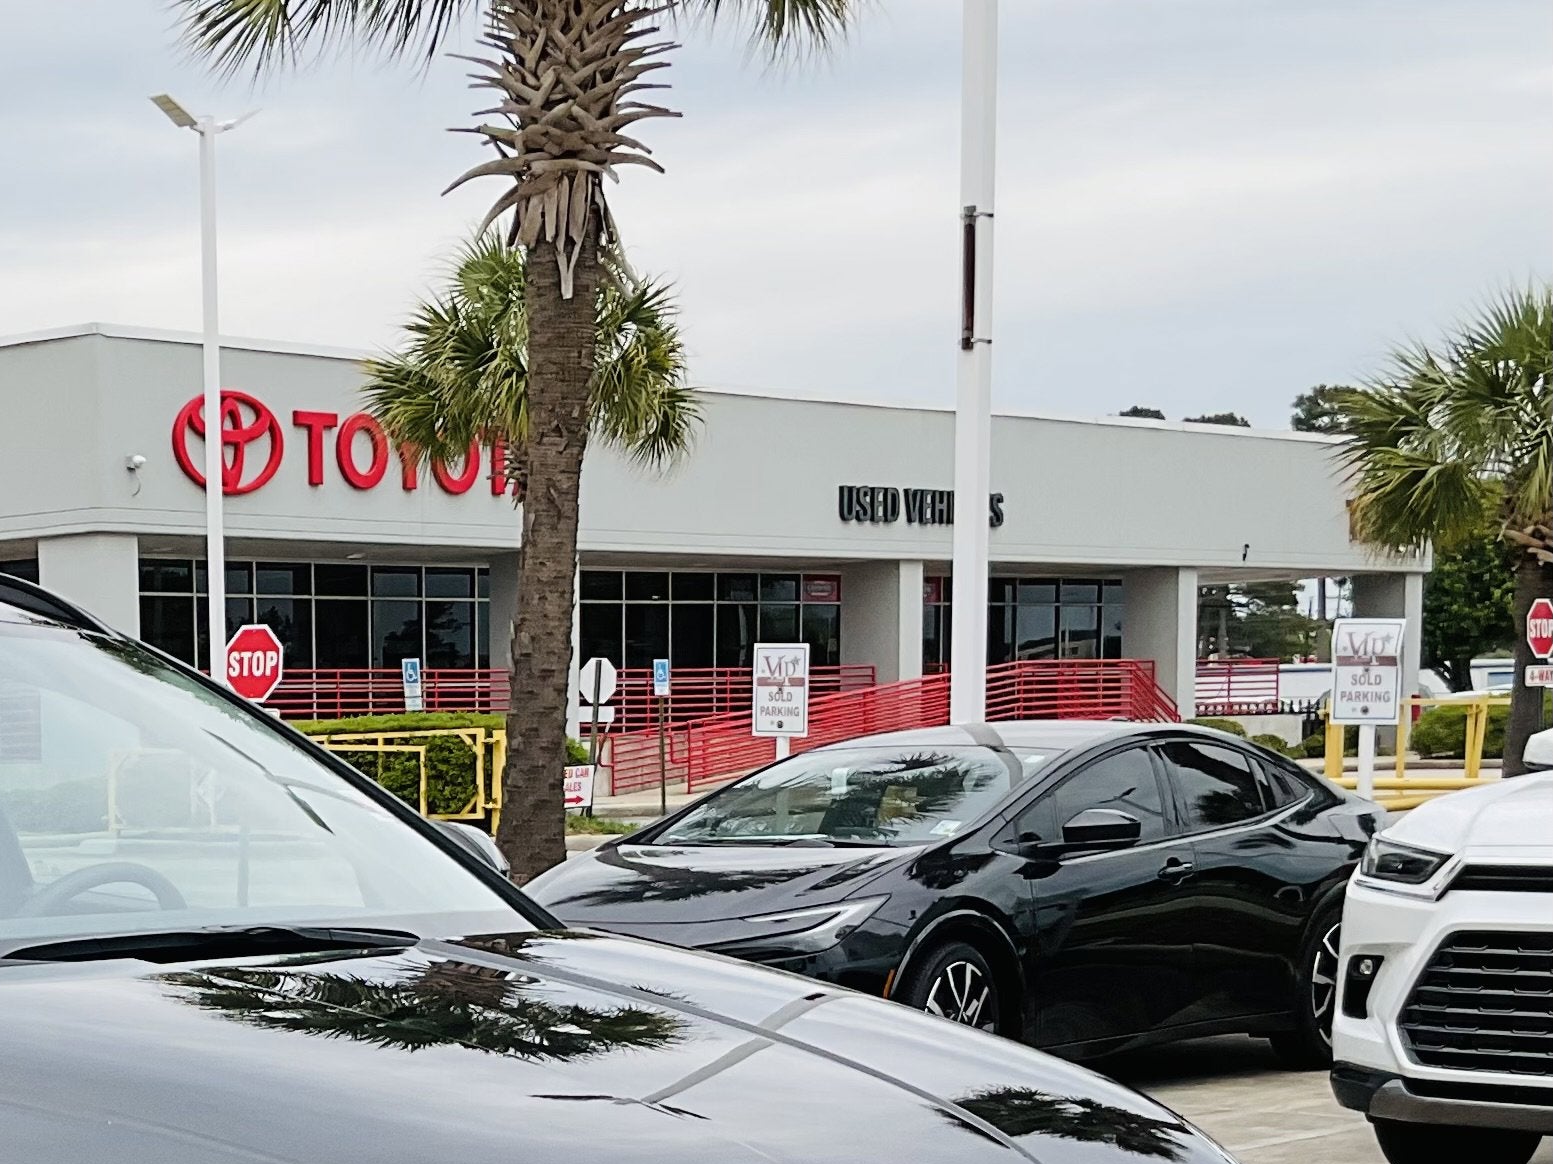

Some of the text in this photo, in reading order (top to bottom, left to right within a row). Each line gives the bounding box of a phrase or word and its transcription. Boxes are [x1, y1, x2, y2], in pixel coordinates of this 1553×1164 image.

[293, 410, 520, 496] TOYOT
[838, 485, 1004, 527] USED VEHIS
[228, 650, 278, 677] STOP
[1350, 674, 1382, 686] SOLD
[768, 691, 793, 702] SOLD
[1340, 691, 1391, 703] PARKING
[760, 706, 800, 717] PARKING
[564, 782, 581, 792] ALES
